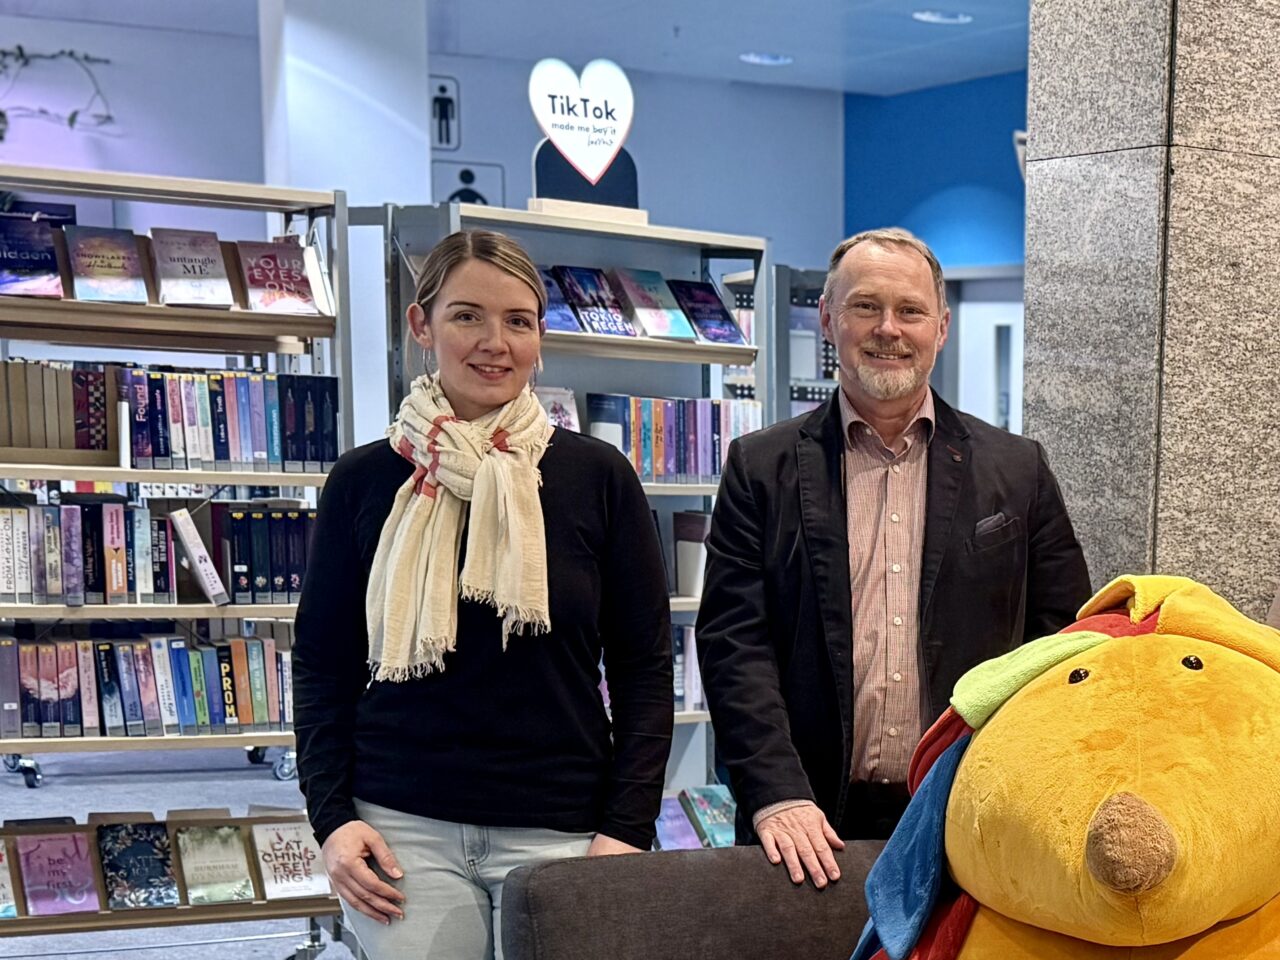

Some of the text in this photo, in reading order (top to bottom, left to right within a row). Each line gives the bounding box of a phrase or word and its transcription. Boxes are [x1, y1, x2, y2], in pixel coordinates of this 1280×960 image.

[547, 94, 618, 121] TikTok
[551, 122, 575, 132] made
[577, 125, 590, 133] me
[169, 256, 217, 267] untangle
[247, 257, 302, 270] YOUR
[181, 264, 210, 276] ME
[253, 268, 302, 281] EYES
[265, 281, 295, 292] ON
[580, 310, 622, 322] TOKIO
[591, 321, 636, 334] REGEN
[134, 384, 146, 422] Found
[220, 663, 236, 717] PROM
[272, 840, 302, 852] CAT
[262, 851, 316, 863] CHING
